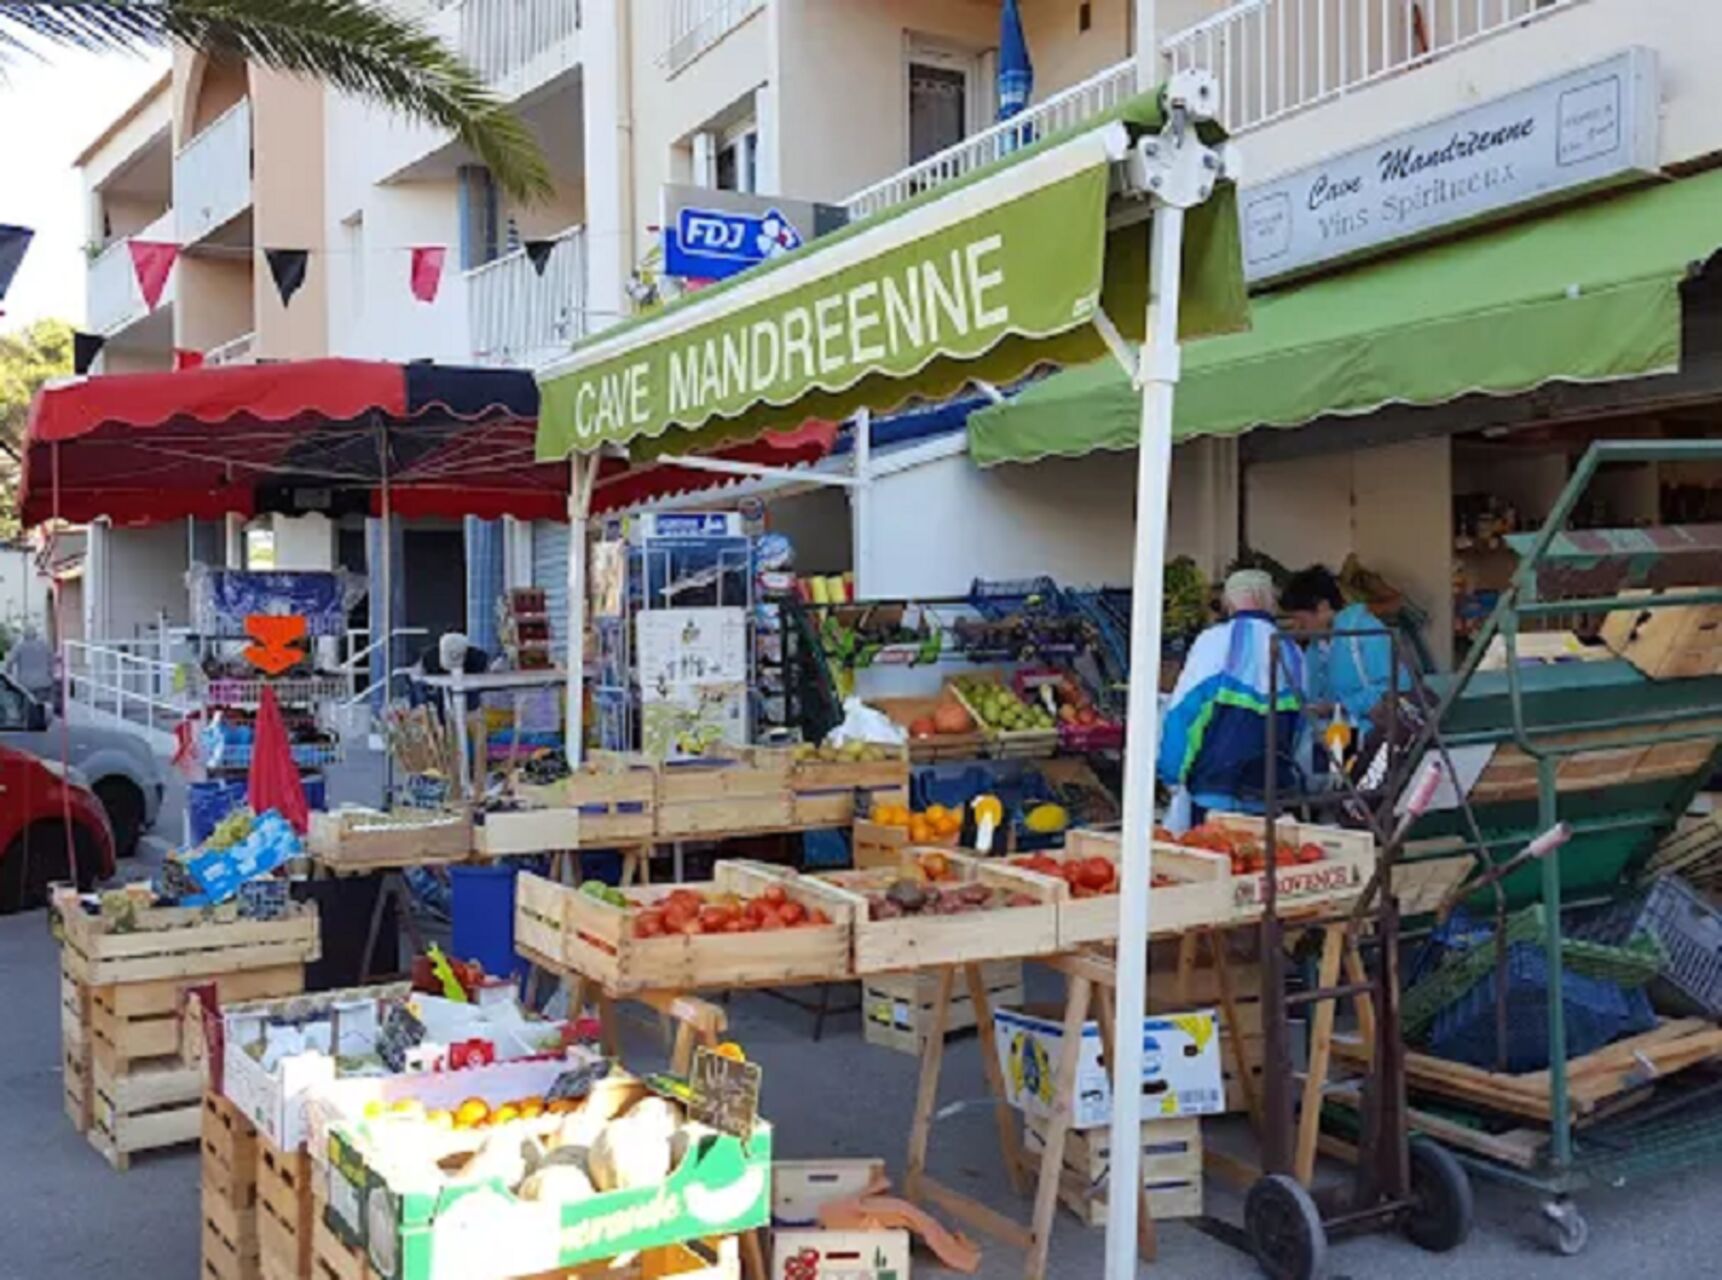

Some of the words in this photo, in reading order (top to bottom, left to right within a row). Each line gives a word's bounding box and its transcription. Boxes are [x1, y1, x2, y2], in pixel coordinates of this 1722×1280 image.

[1308, 173, 1362, 211] Cave
[1318, 207, 1369, 240] Vins
[1380, 163, 1517, 224] Spiritueux
[686, 217, 746, 249] FDJ
[574, 362, 651, 438] CAVE
[668, 234, 1008, 413] MANDREENNE
[1258, 865, 1347, 904] POVENCE
